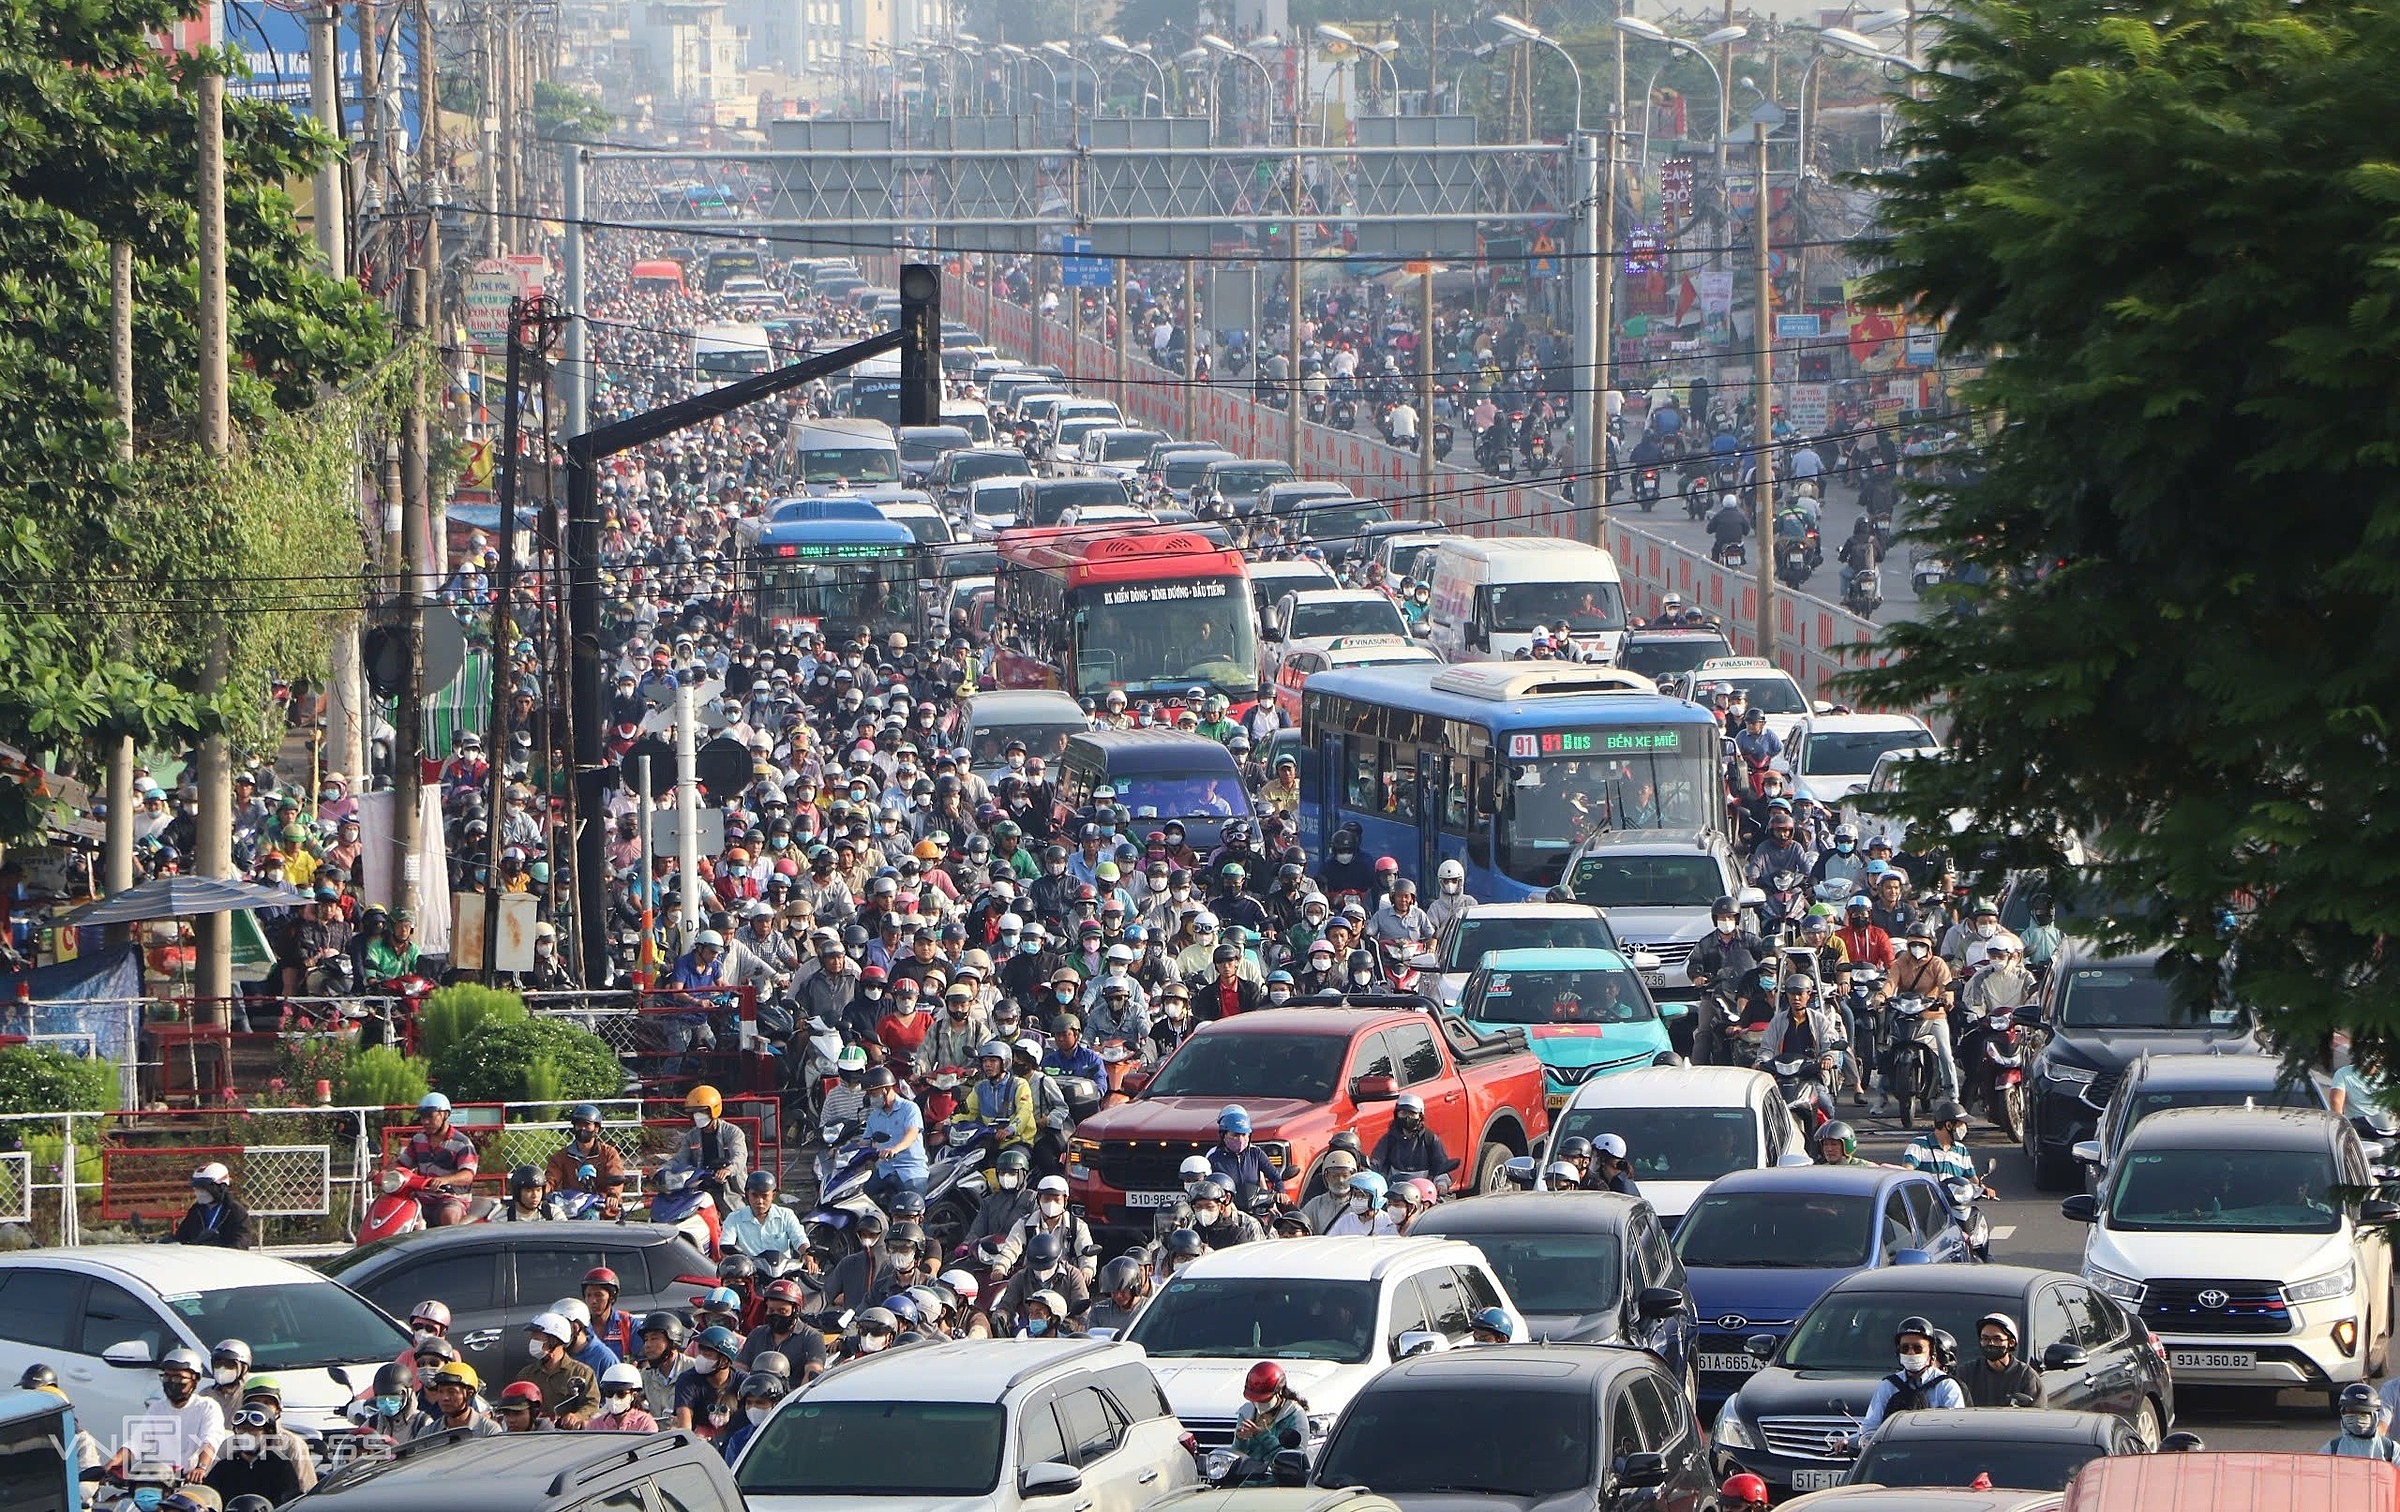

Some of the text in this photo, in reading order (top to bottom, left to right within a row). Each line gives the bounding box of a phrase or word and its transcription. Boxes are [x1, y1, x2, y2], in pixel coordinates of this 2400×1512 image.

[1151, 585, 1167, 601] BÌNH
[1515, 736, 1532, 756] 91
[1635, 736, 1652, 748] XE
[2177, 1354, 2249, 1367] 93A-360.82
